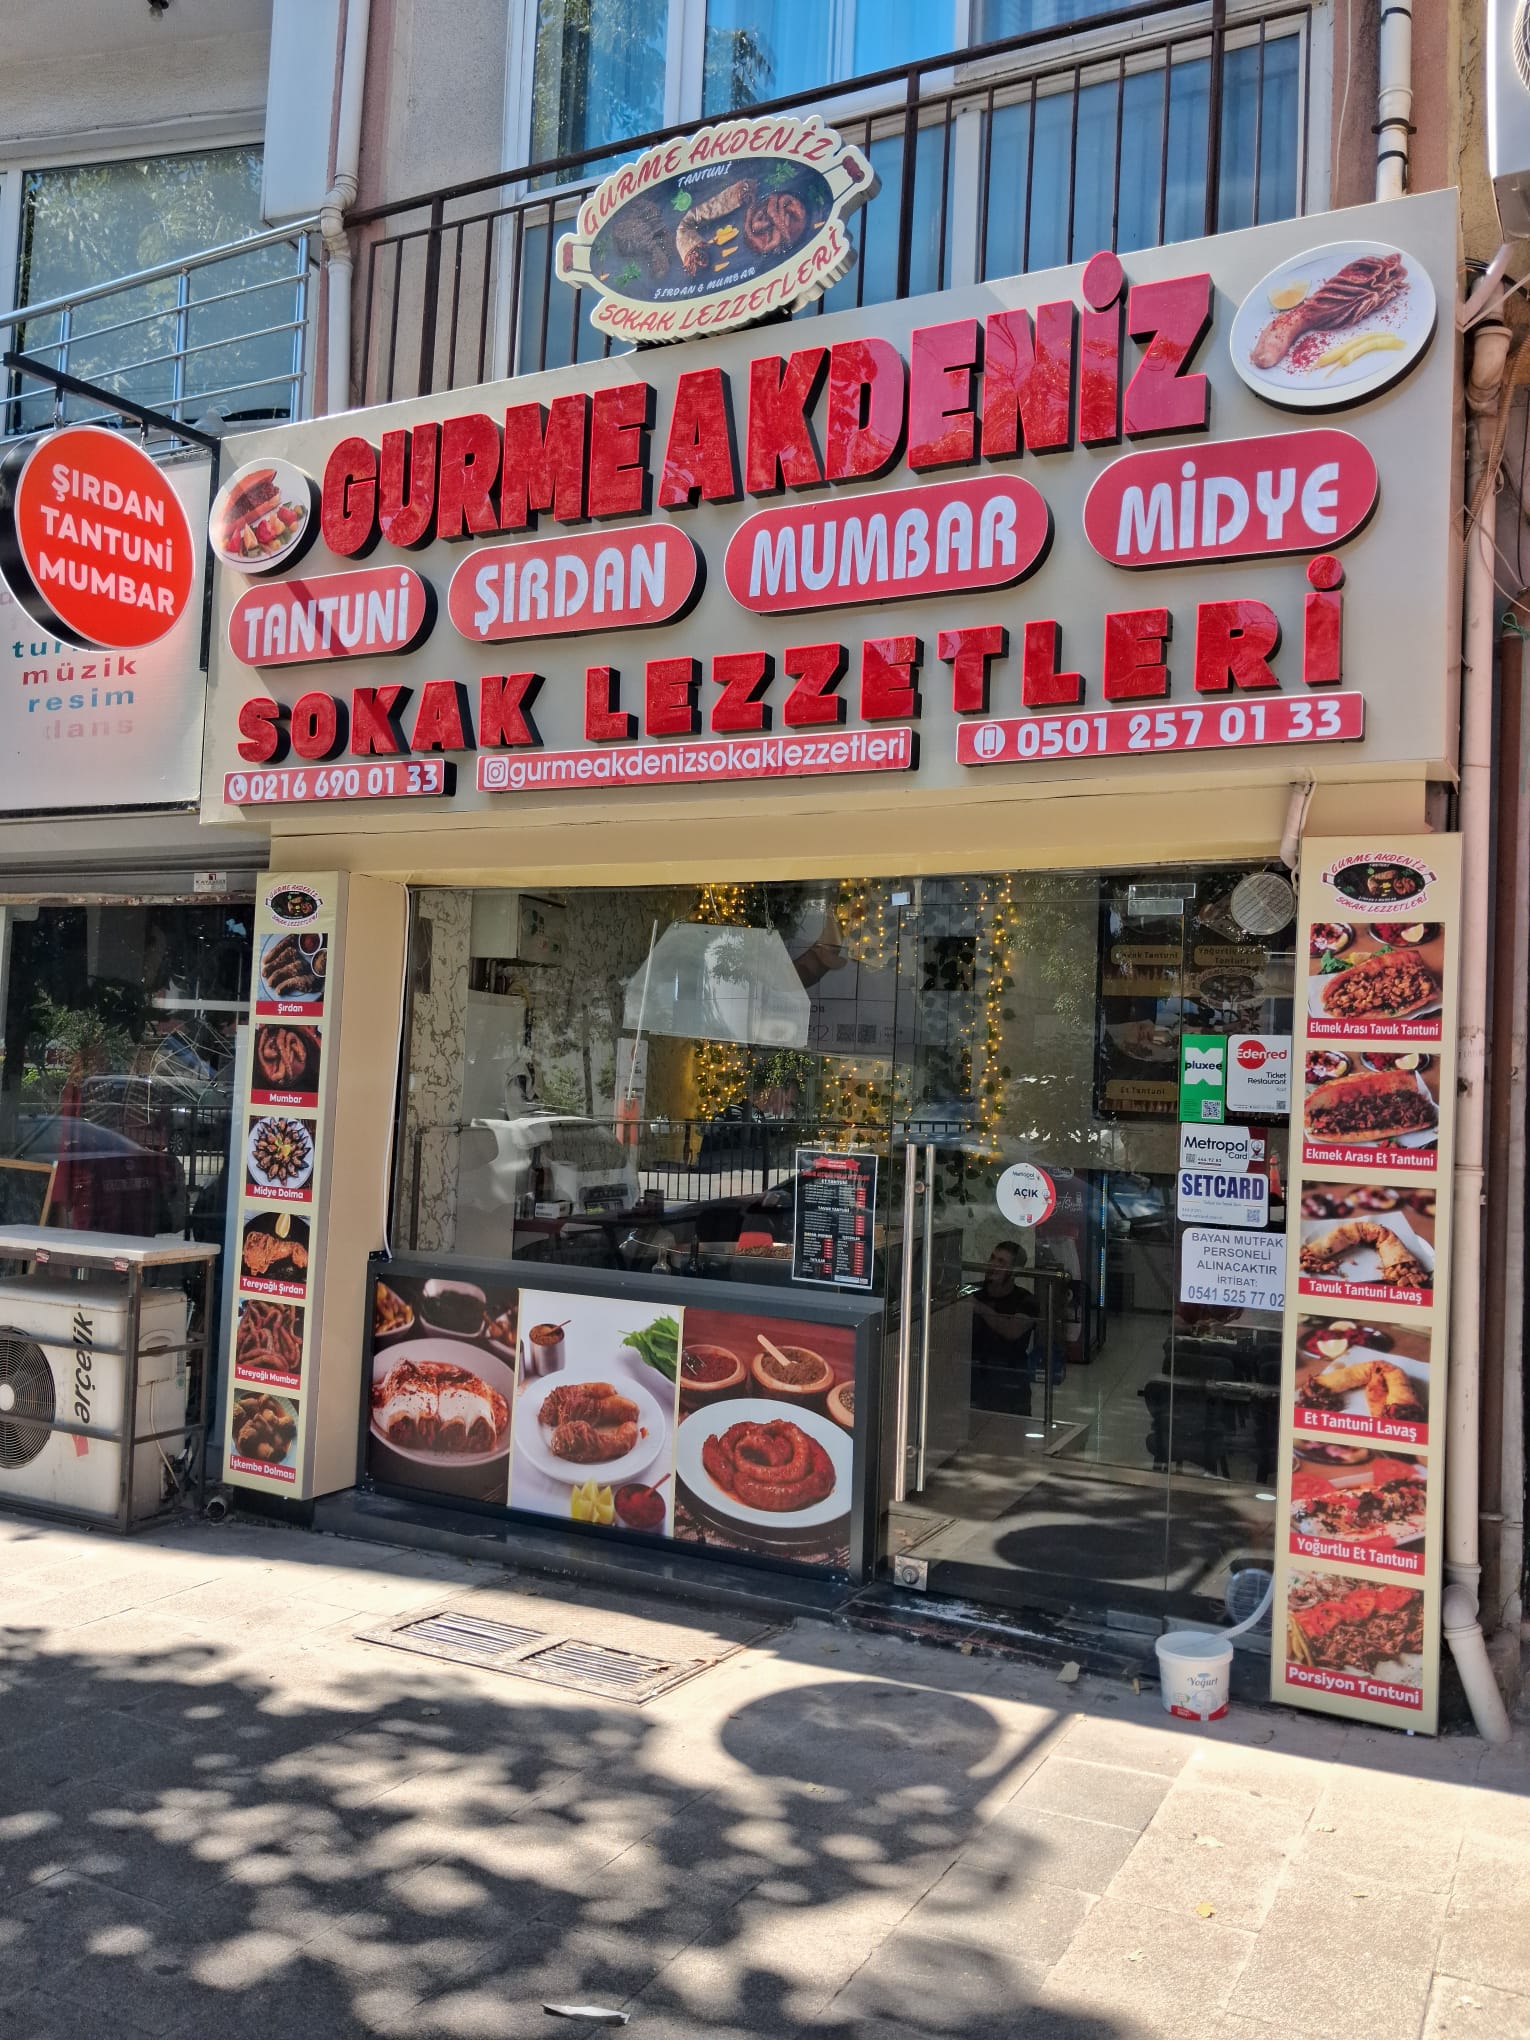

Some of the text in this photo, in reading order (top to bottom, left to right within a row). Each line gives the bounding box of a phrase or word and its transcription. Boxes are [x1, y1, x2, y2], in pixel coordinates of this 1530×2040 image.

[583, 124, 842, 237] GURME AKDENİZ
[677, 161, 732, 188] TANTUNİ
[598, 225, 843, 333] SOKAK LEZZETLERİ
[654, 285, 697, 299] ŞIRDAN
[706, 267, 756, 291] MUMBAR
[321, 251, 1211, 557] GURME AKDENİZ
[51, 463, 164, 528] ŞIRDAN
[40, 504, 174, 573] TANTUNİ
[243, 460, 1340, 659] TANTUNİ ŞIRDAN MUMBAR MİDYE
[38, 551, 175, 616] MUMBAR
[22, 655, 137, 685] müzik
[236, 553, 1343, 764] SOKAK LEZZETLERİ
[28, 687, 135, 713] resim
[1017, 699, 1342, 758] 0501 257 01 33
[509, 731, 905, 789] gurmeakdenizsokaklezzetleri
[250, 763, 438, 801] 0216 690 01 33
[1330, 853, 1373, 874] GURME
[277, 1003, 303, 1014] Şırdan
[1310, 1022, 1439, 1036] Ekmek Arası Tavuk Tantuni
[1184, 1060, 1223, 1071] pluxee
[1237, 1048, 1288, 1060] Edenred
[1247, 1077, 1287, 1085] Restaurant
[1266, 1071, 1287, 1079] Ticket
[269, 1093, 303, 1104] Mumbar
[1184, 1135, 1249, 1154] Metropol
[1228, 1151, 1248, 1160] Card
[1306, 1149, 1434, 1166] Ekmek Arası Et Tantuni
[253, 1186, 304, 1199] Midye Dolma
[1013, 1188, 1039, 1199] AÇIK
[1181, 1173, 1265, 1201] SETCARD
[1191, 1232, 1284, 1248] BAYAN MUTFAK
[1203, 1246, 1272, 1261] PERSONELİ
[1196, 1260, 1278, 1276] ALINACAKTIR
[278, 1283, 304, 1296] Şırdan
[1217, 1273, 1258, 1288] İRTİBAT:
[1308, 1280, 1423, 1305] Tavuk Tantuni Lavaş
[1187, 1285, 1285, 1308] 0541 525 77 02
[269, 1374, 299, 1386] Mumbar
[1304, 1411, 1418, 1442] Et Tantuni Lavaş
[1297, 1536, 1419, 1570] Yoğurtlu Et Tantuni
[1288, 1666, 1420, 1705] Porsiyon Tantuni
